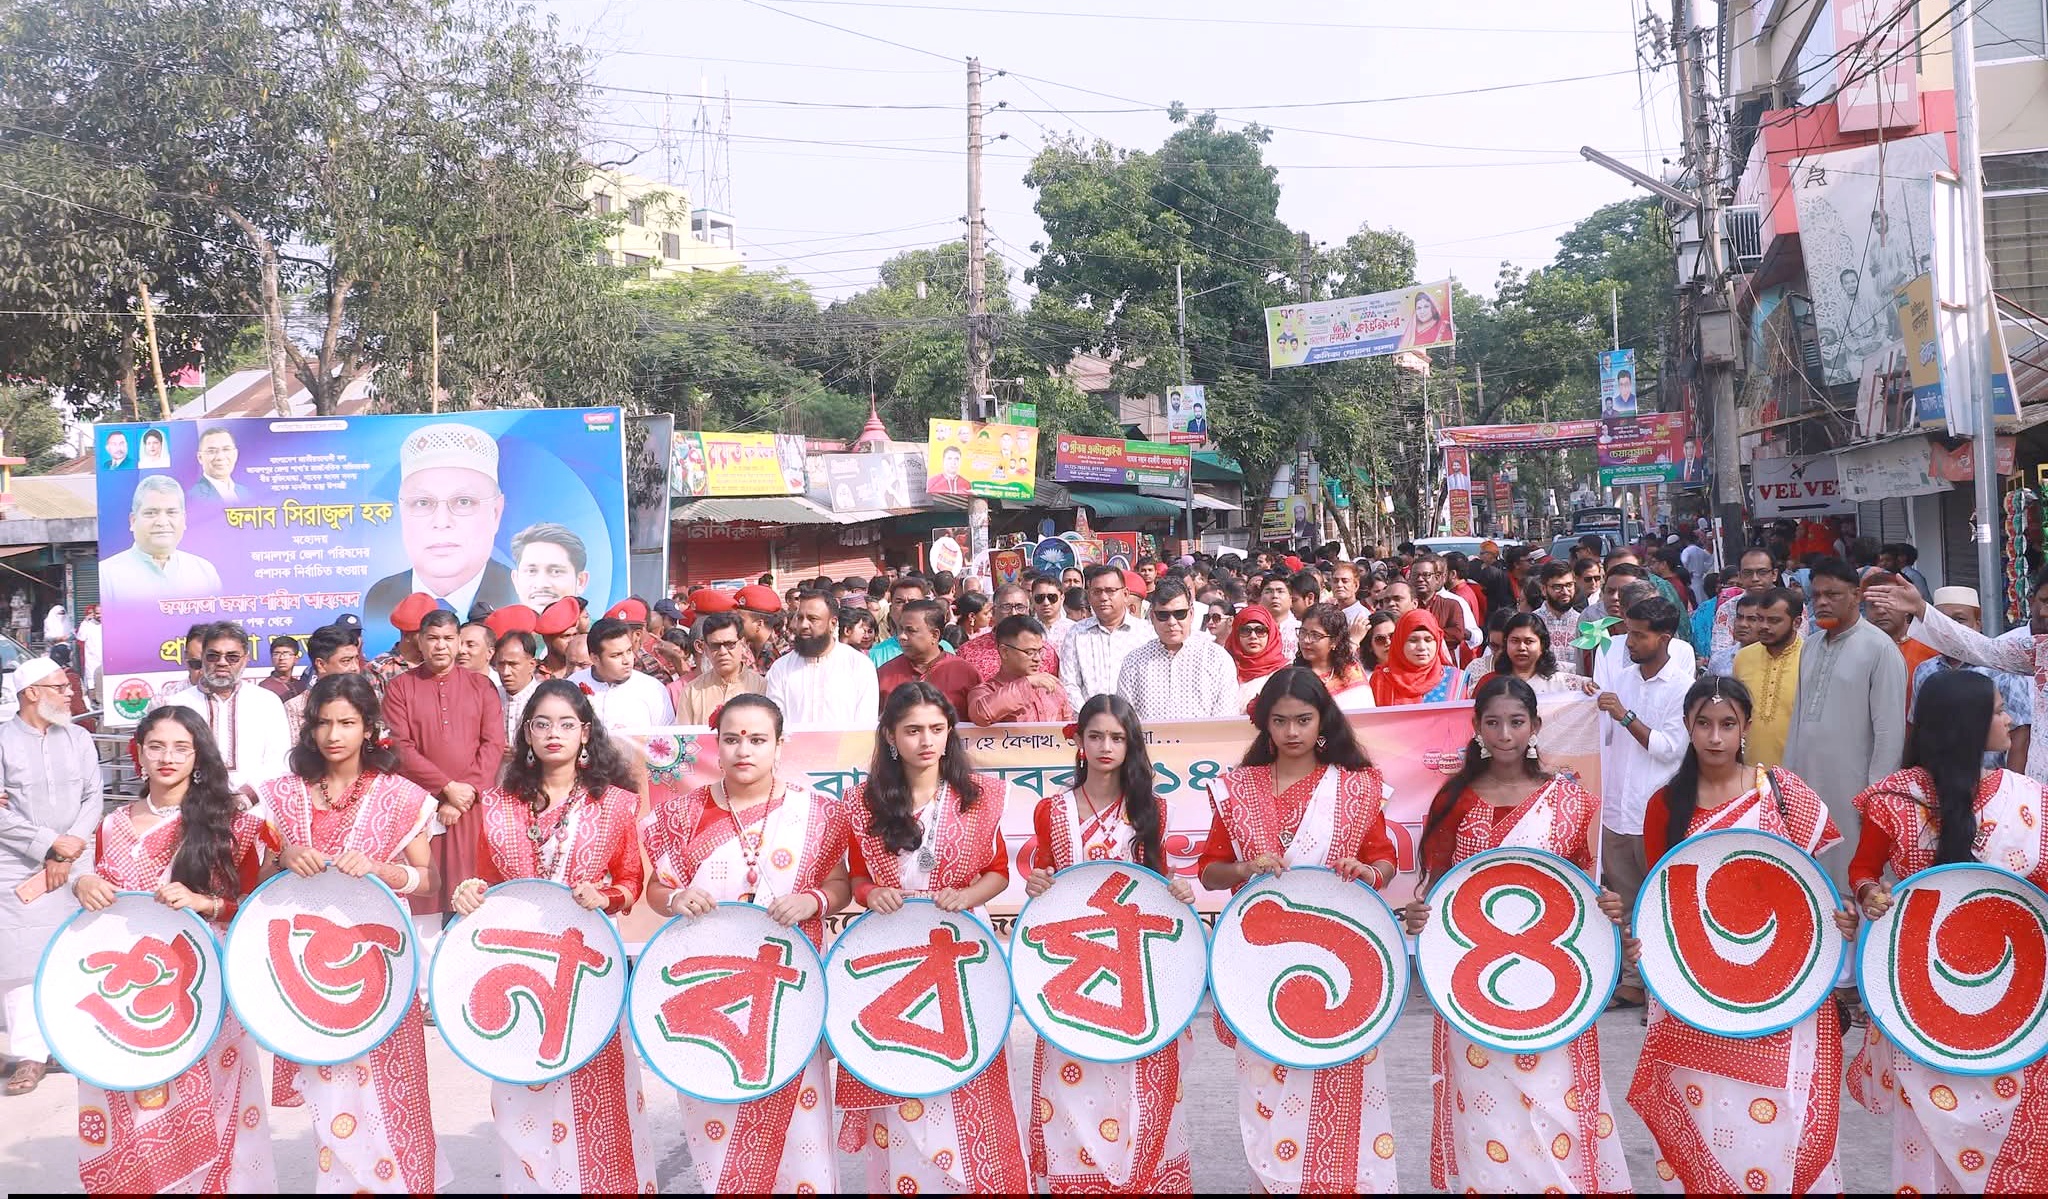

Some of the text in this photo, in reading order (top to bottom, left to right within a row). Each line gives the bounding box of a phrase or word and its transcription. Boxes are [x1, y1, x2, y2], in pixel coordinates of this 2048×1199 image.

[1609, 447, 1653, 459] চেয়ারম্যান
[1757, 480, 1840, 500] VELVE
[225, 499, 393, 531] জনাব সিরাজুল হক
[250, 546, 370, 563] জামালপুর জেলা পরিষদের
[292, 534, 328, 545] মহোদয়
[254, 564, 368, 579] প্রশাসক নির্বাচিত হওয়ায়
[159, 597, 216, 616] জননেতা
[219, 595, 258, 613] জনাব
[259, 588, 301, 612] শামীম
[246, 615, 265, 628] পক্ষ
[267, 614, 294, 628] থেকে
[976, 729, 1061, 751] হে বৈশাখ,
[1660, 849, 1824, 1014] ৩
[1441, 855, 1594, 1041] ৪
[266, 913, 406, 1037] ভ
[1236, 889, 1394, 1050] ১
[1888, 887, 2048, 1060] ৩
[461, 926, 612, 1068] ন
[844, 921, 990, 1072] ব
[655, 936, 807, 1090] ব
